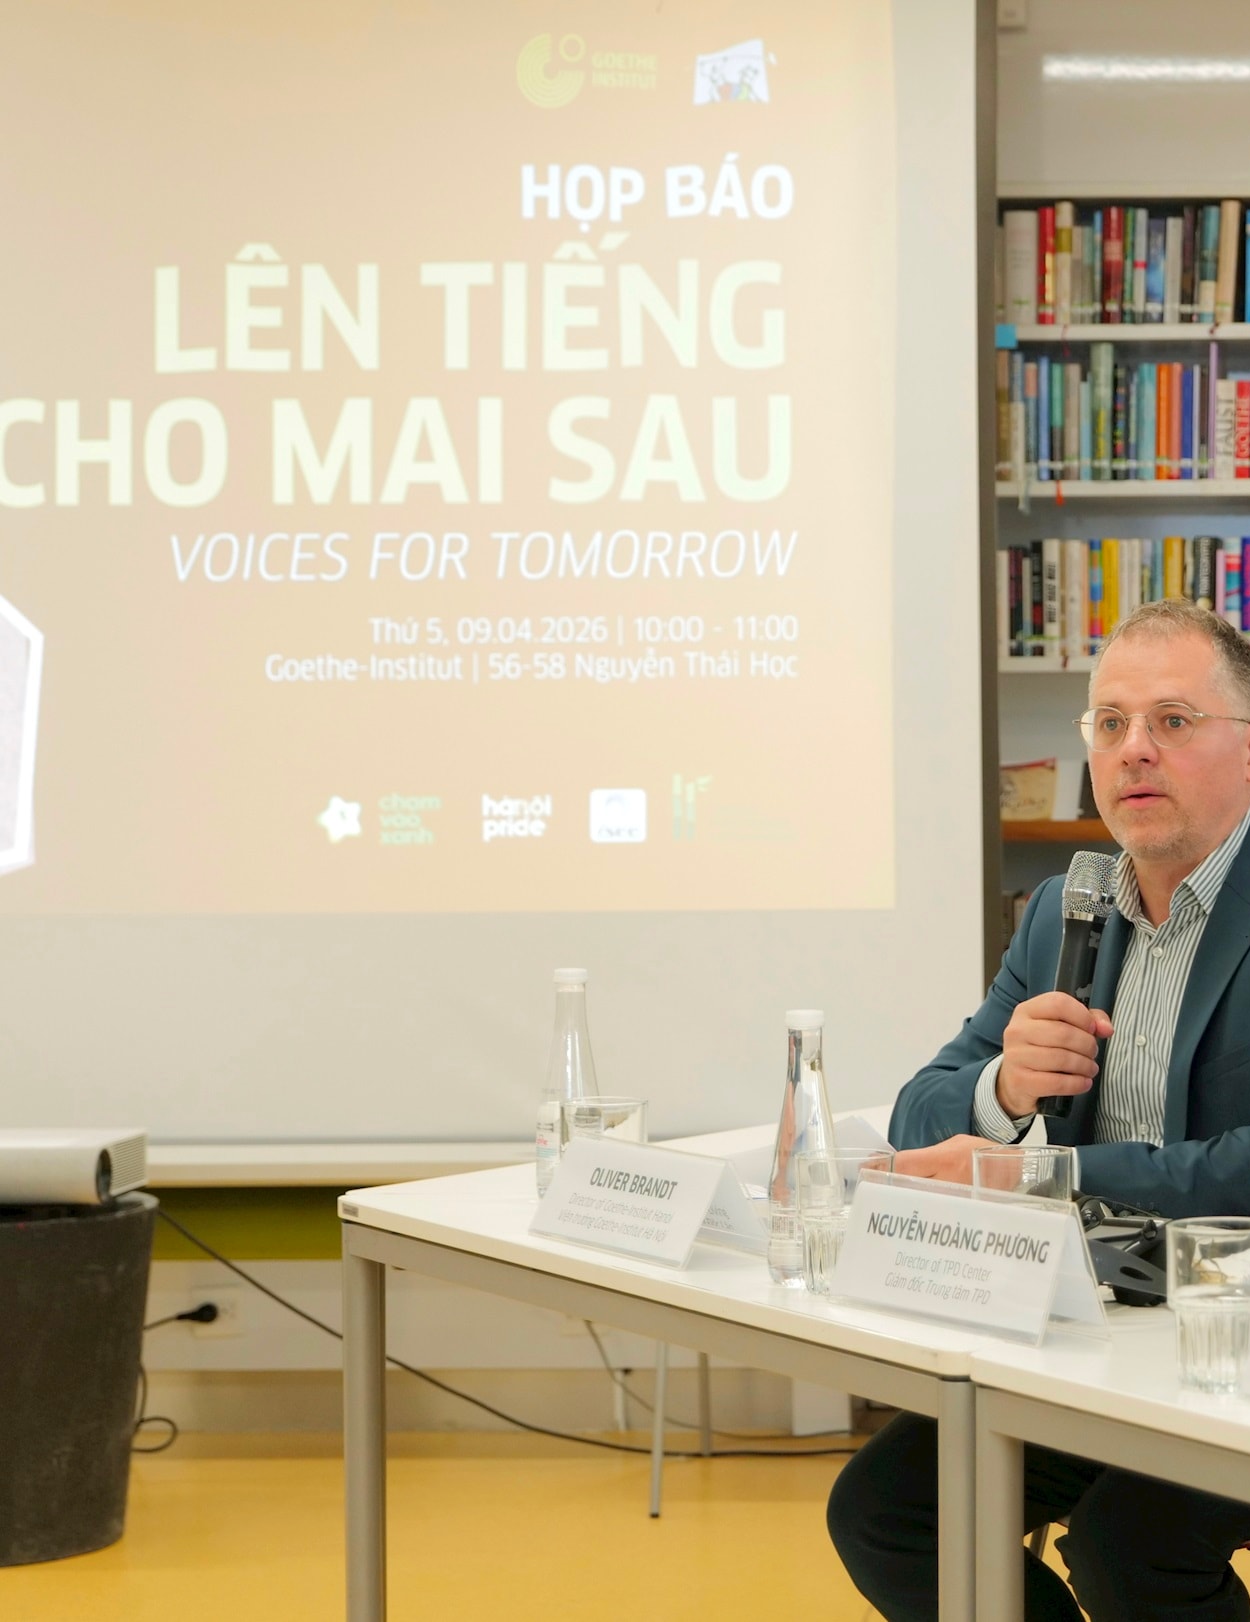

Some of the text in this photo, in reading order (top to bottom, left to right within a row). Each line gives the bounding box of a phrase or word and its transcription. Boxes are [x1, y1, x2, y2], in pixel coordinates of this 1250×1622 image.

[520, 153, 795, 232] HỌP BÁO
[154, 232, 786, 373] LÊN TIẾNG
[0, 394, 793, 508] CHO MAI SAU
[171, 529, 798, 582] VOICES FOR TOMORROW
[369, 616, 420, 646] Thứ
[457, 616, 608, 644] 09.04.2026
[634, 615, 703, 643] 10:00
[733, 614, 799, 642] 11:00
[264, 652, 463, 683] Goethe-Institut
[488, 653, 566, 680] 56-58
[574, 649, 675, 684] Nguyễn
[685, 651, 740, 679] Thái
[749, 652, 799, 680] Học
[590, 1167, 678, 1200] OLIVER BRANDT
[867, 1210, 1050, 1263] NGUYỄN HOÀNG PHƯƠNG
[884, 1271, 991, 1305] Giám đốc Trung tâm TPD
[895, 1251, 992, 1282] Director of TPD Center
